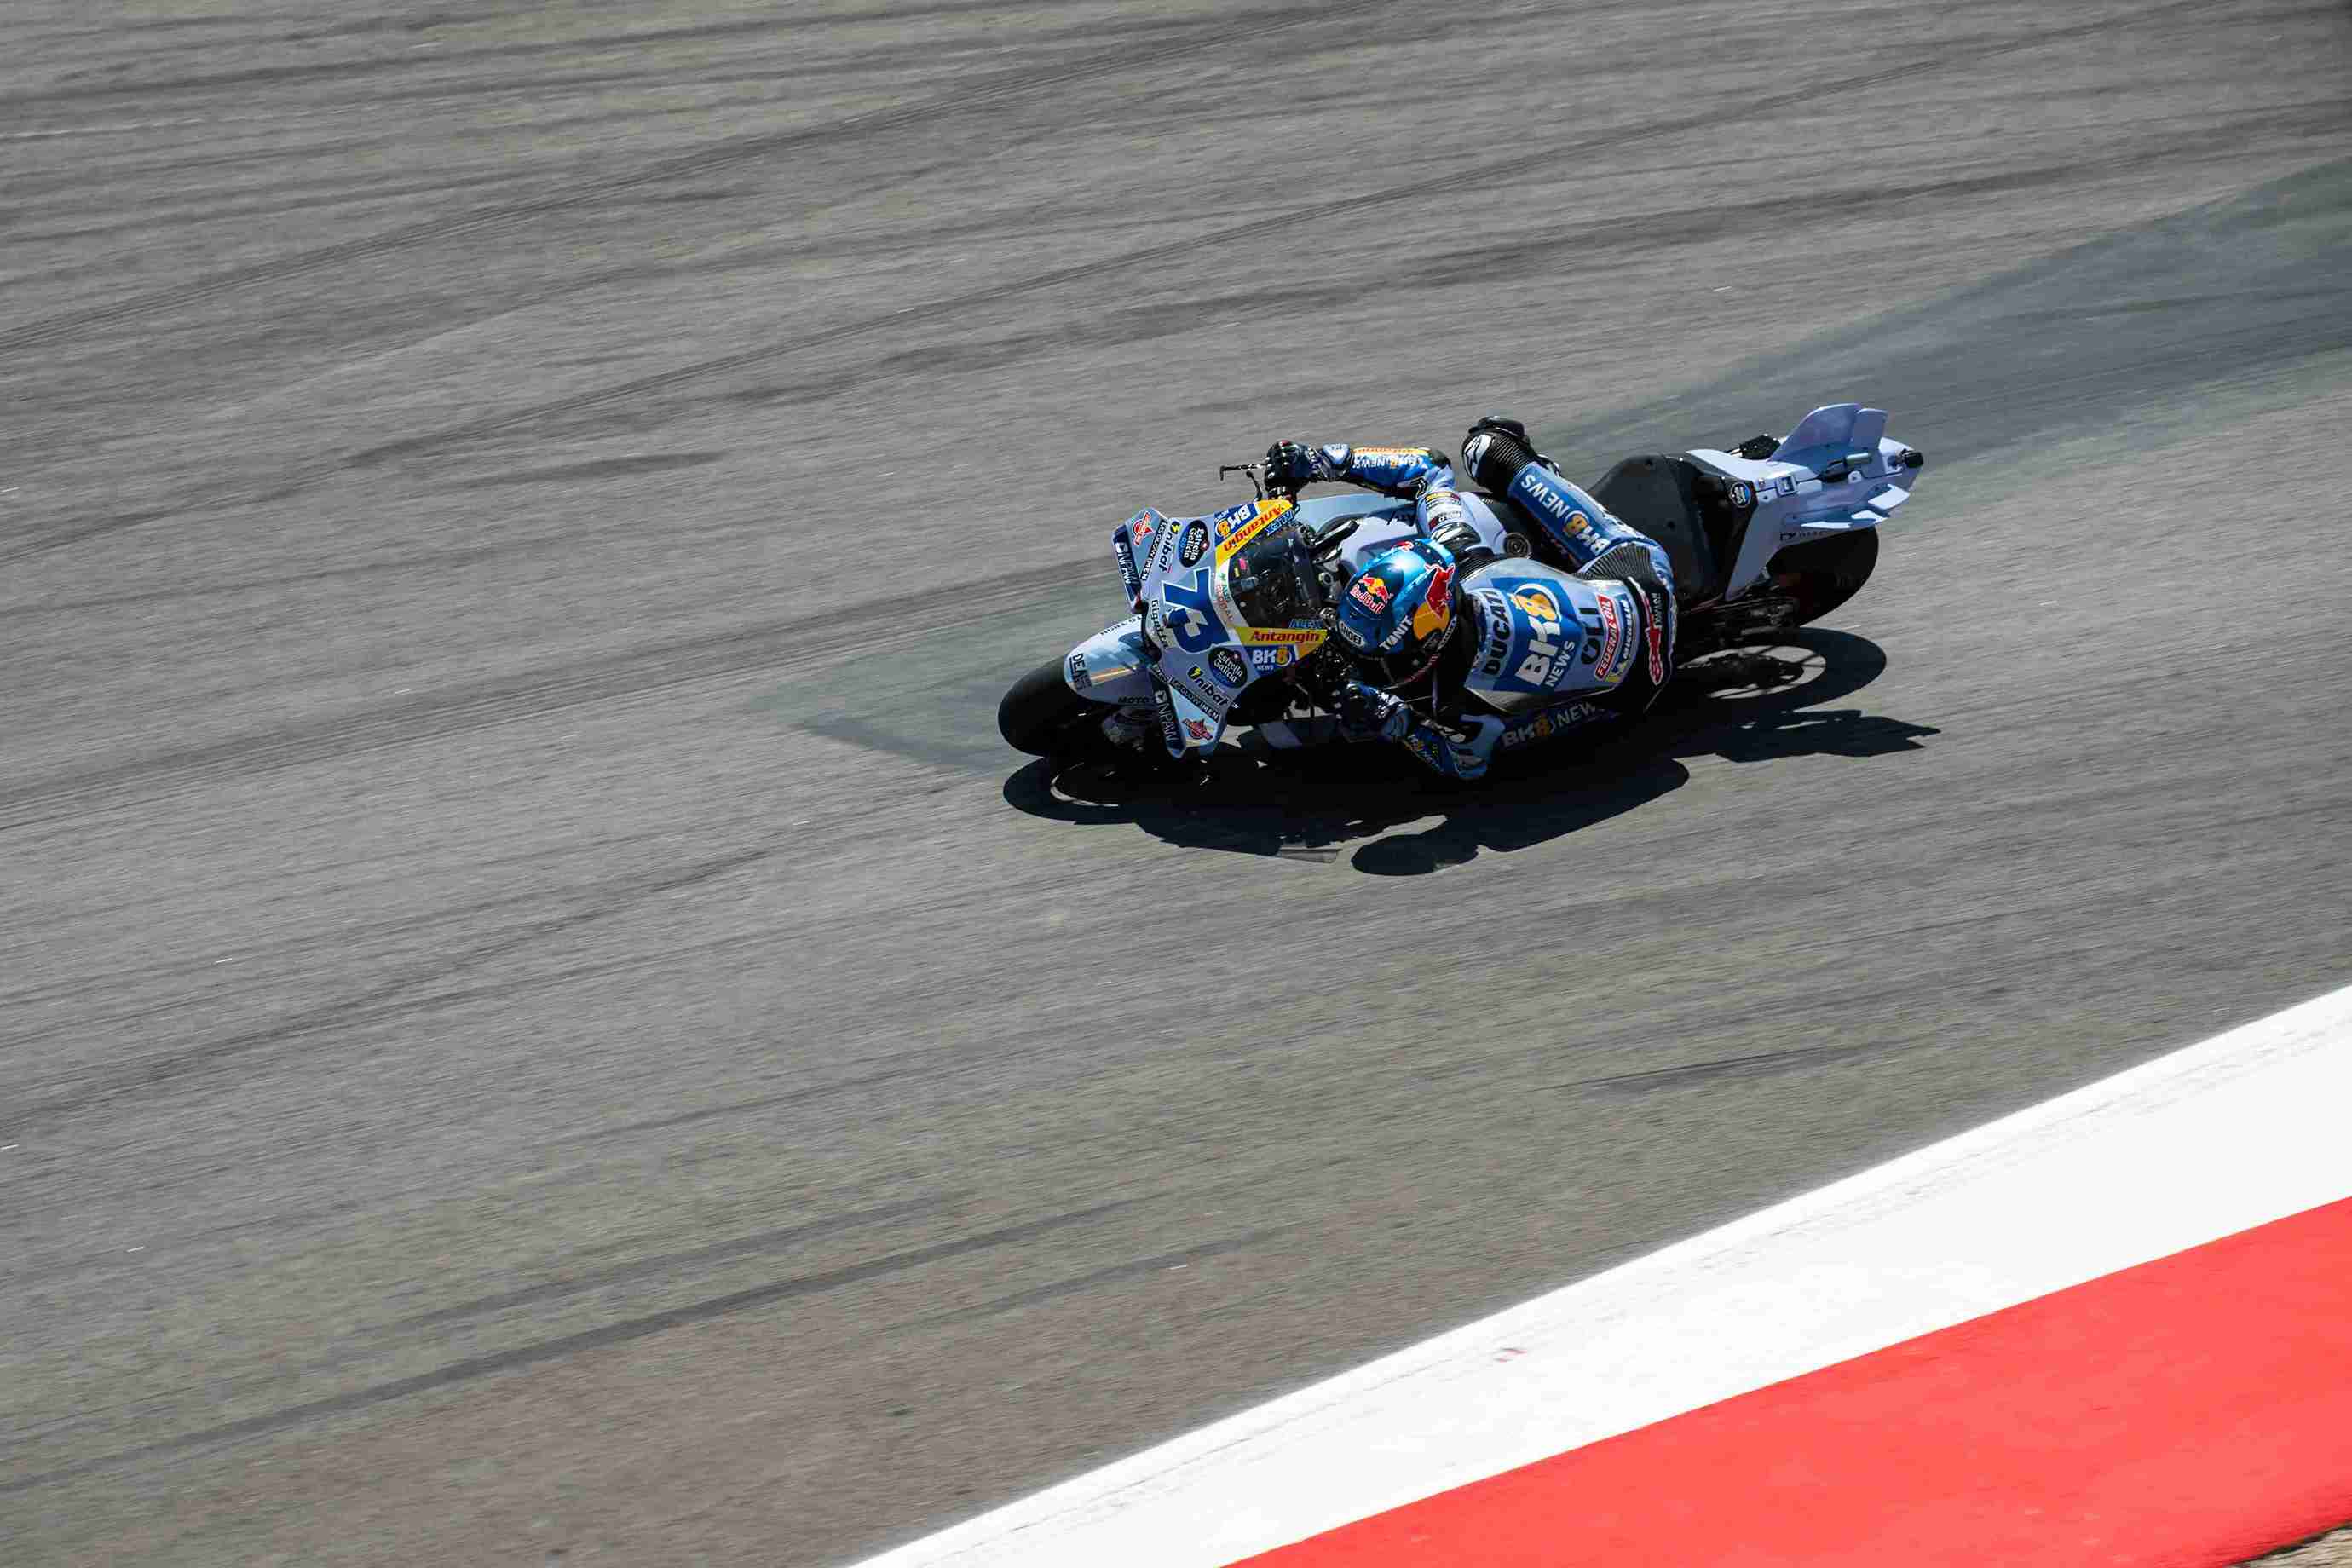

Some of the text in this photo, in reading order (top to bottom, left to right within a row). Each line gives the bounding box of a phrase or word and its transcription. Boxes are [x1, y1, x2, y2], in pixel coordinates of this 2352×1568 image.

[1521, 475, 1570, 518] NEWS
[1184, 527, 1197, 558] Galicia
[1190, 528, 1204, 561] Estrella
[1162, 566, 1231, 653] 73
[1249, 631, 1320, 644] Antangin
[1482, 591, 1511, 675] DUCATI
[1509, 590, 1561, 685] BK8
[1213, 660, 1237, 683] Galicia
[1218, 651, 1243, 677] Estrella
[1253, 646, 1289, 666] BK8
[1544, 640, 1575, 687] NEWS
[1558, 700, 1600, 730] NEW
